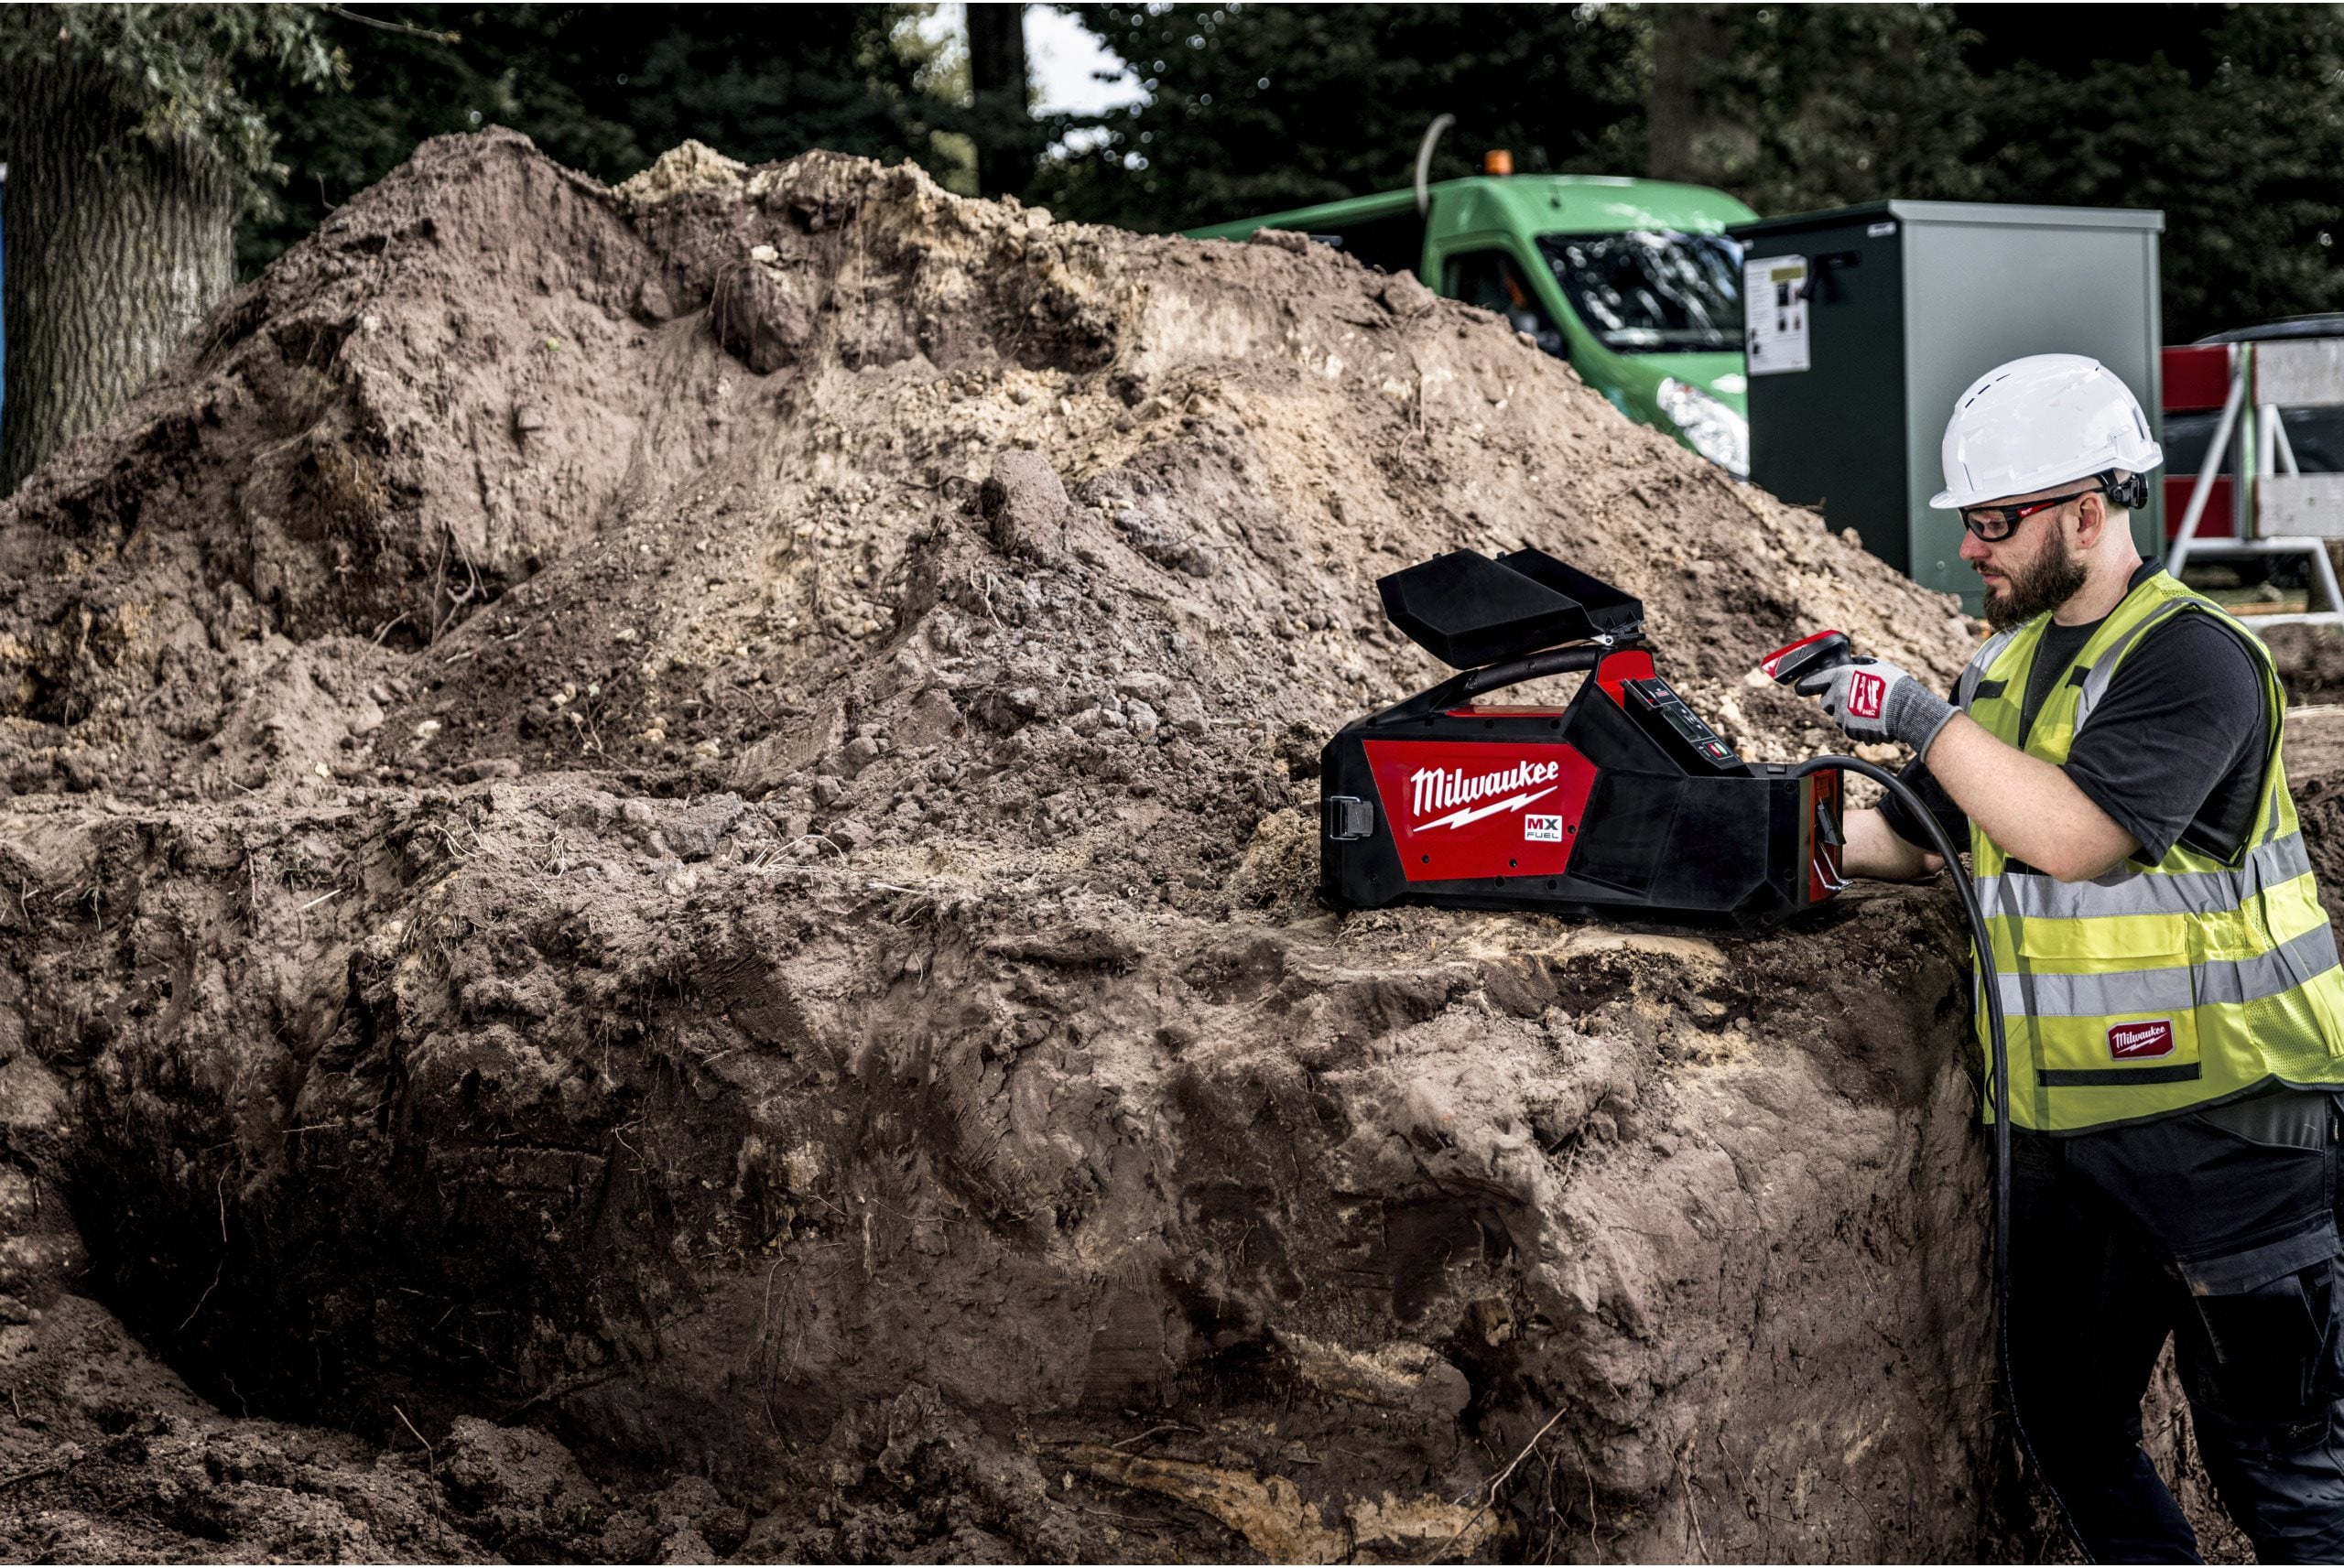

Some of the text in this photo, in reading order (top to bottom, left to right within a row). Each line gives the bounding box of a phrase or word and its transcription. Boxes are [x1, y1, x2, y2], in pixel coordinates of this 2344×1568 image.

[1410, 761, 1559, 816] Milwaukee
[1526, 817, 1558, 830] MX
[1526, 831, 1559, 839] FUEL
[2112, 1025, 2166, 1049] Milwaukee
